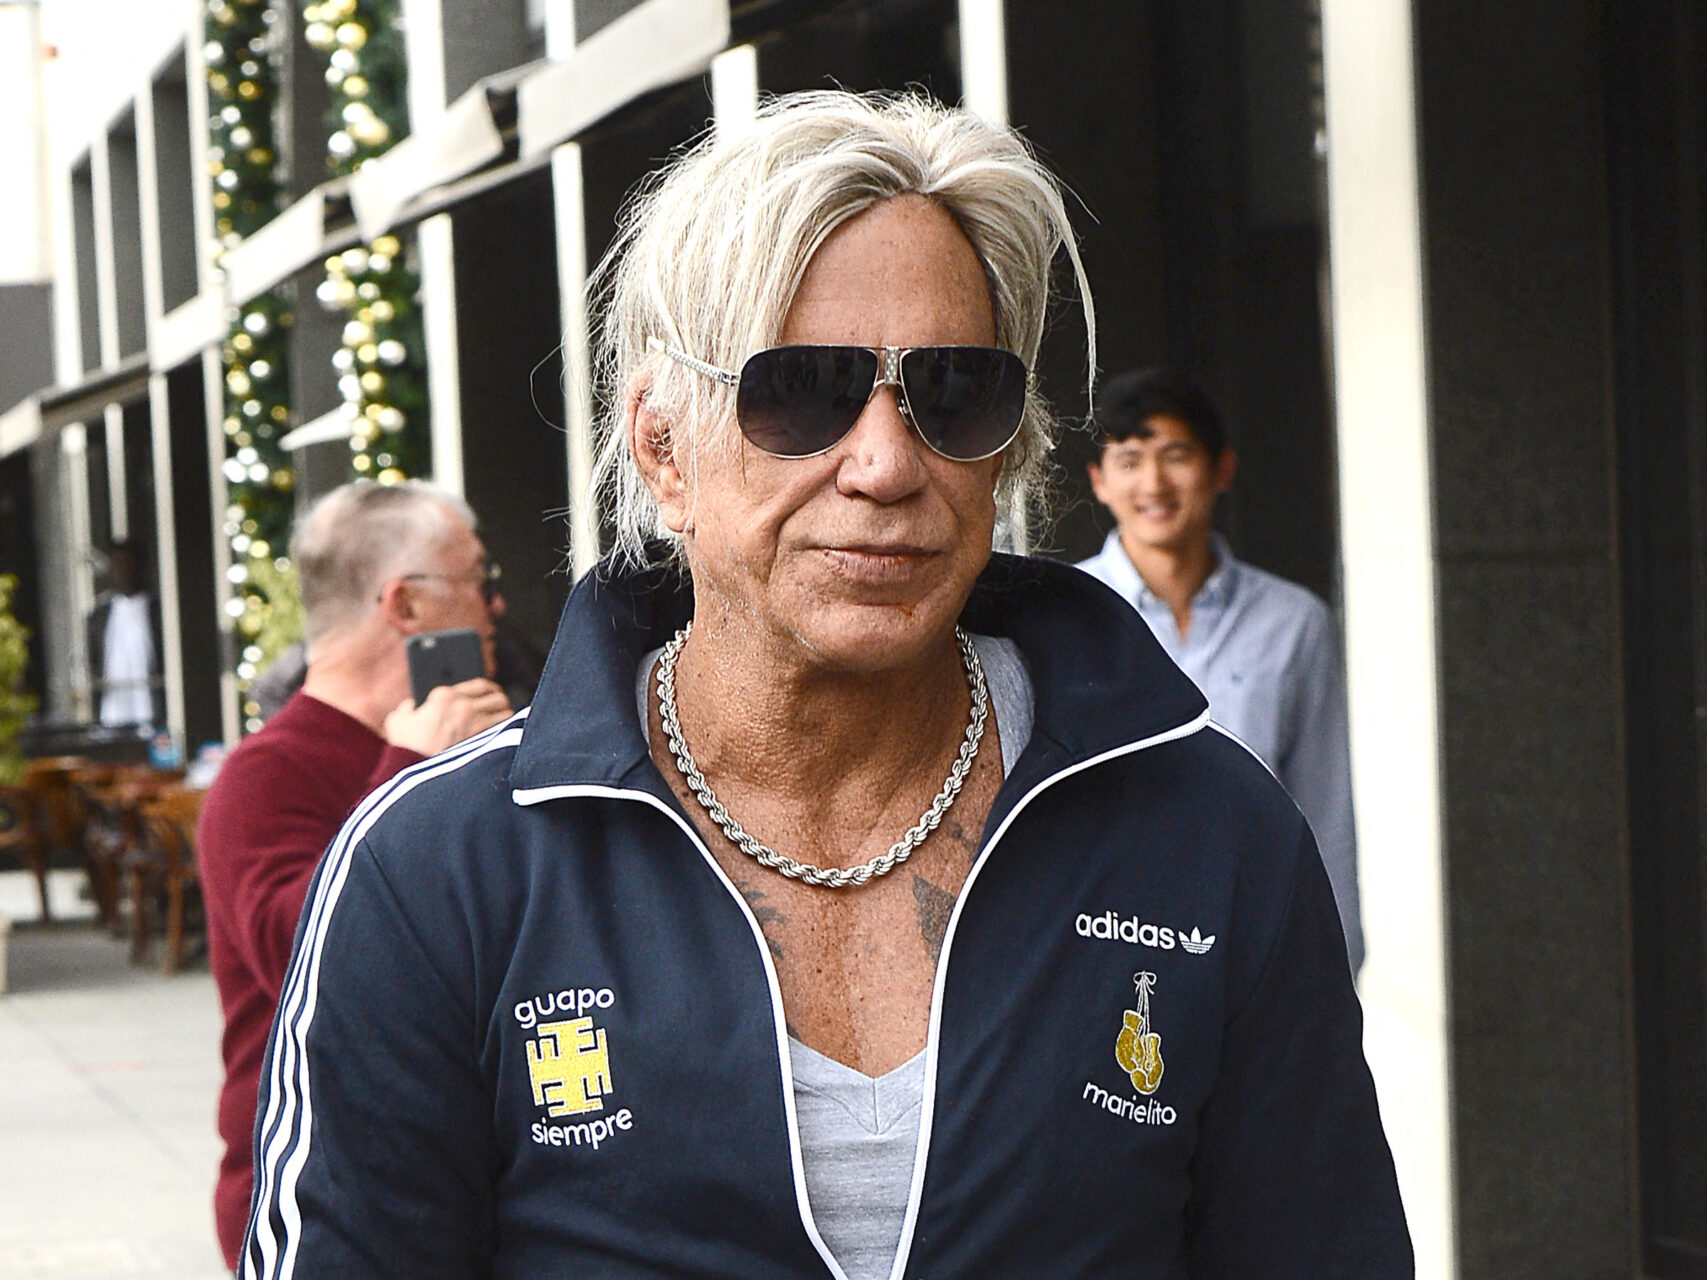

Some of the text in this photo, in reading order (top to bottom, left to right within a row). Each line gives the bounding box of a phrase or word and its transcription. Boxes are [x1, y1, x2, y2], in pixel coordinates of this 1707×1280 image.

[1075, 910, 1176, 950] adidas
[514, 988, 615, 1030] guapo
[1082, 1081, 1177, 1126] marielito
[531, 1108, 633, 1150] siempre
